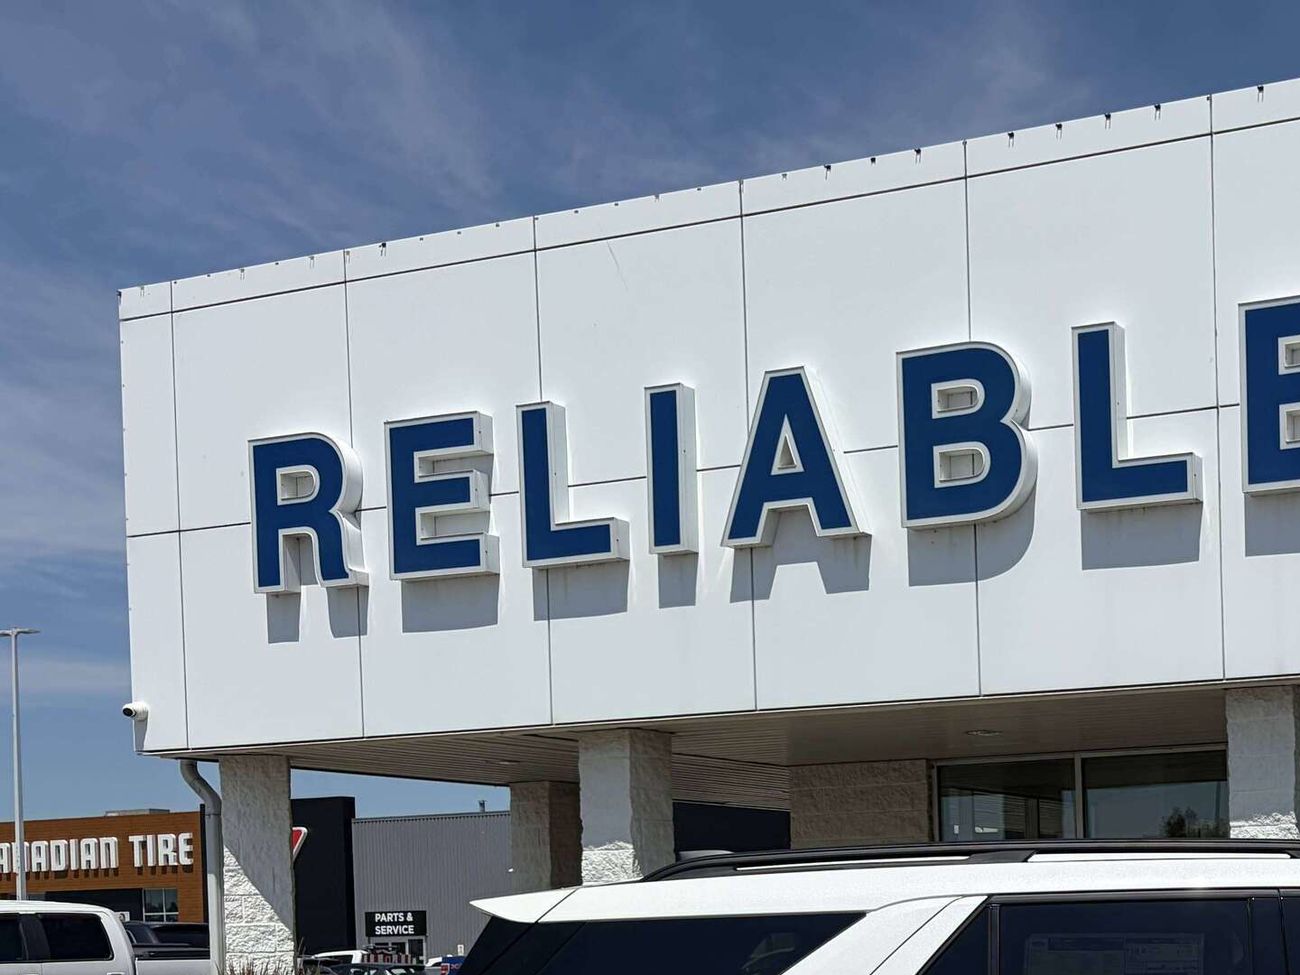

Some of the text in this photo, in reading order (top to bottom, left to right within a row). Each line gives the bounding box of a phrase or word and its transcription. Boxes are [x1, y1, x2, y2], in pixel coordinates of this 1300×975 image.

[128, 832, 194, 868] TIRE
[375, 912, 413, 922] PARTS &
[375, 925, 415, 935] SERVICE
